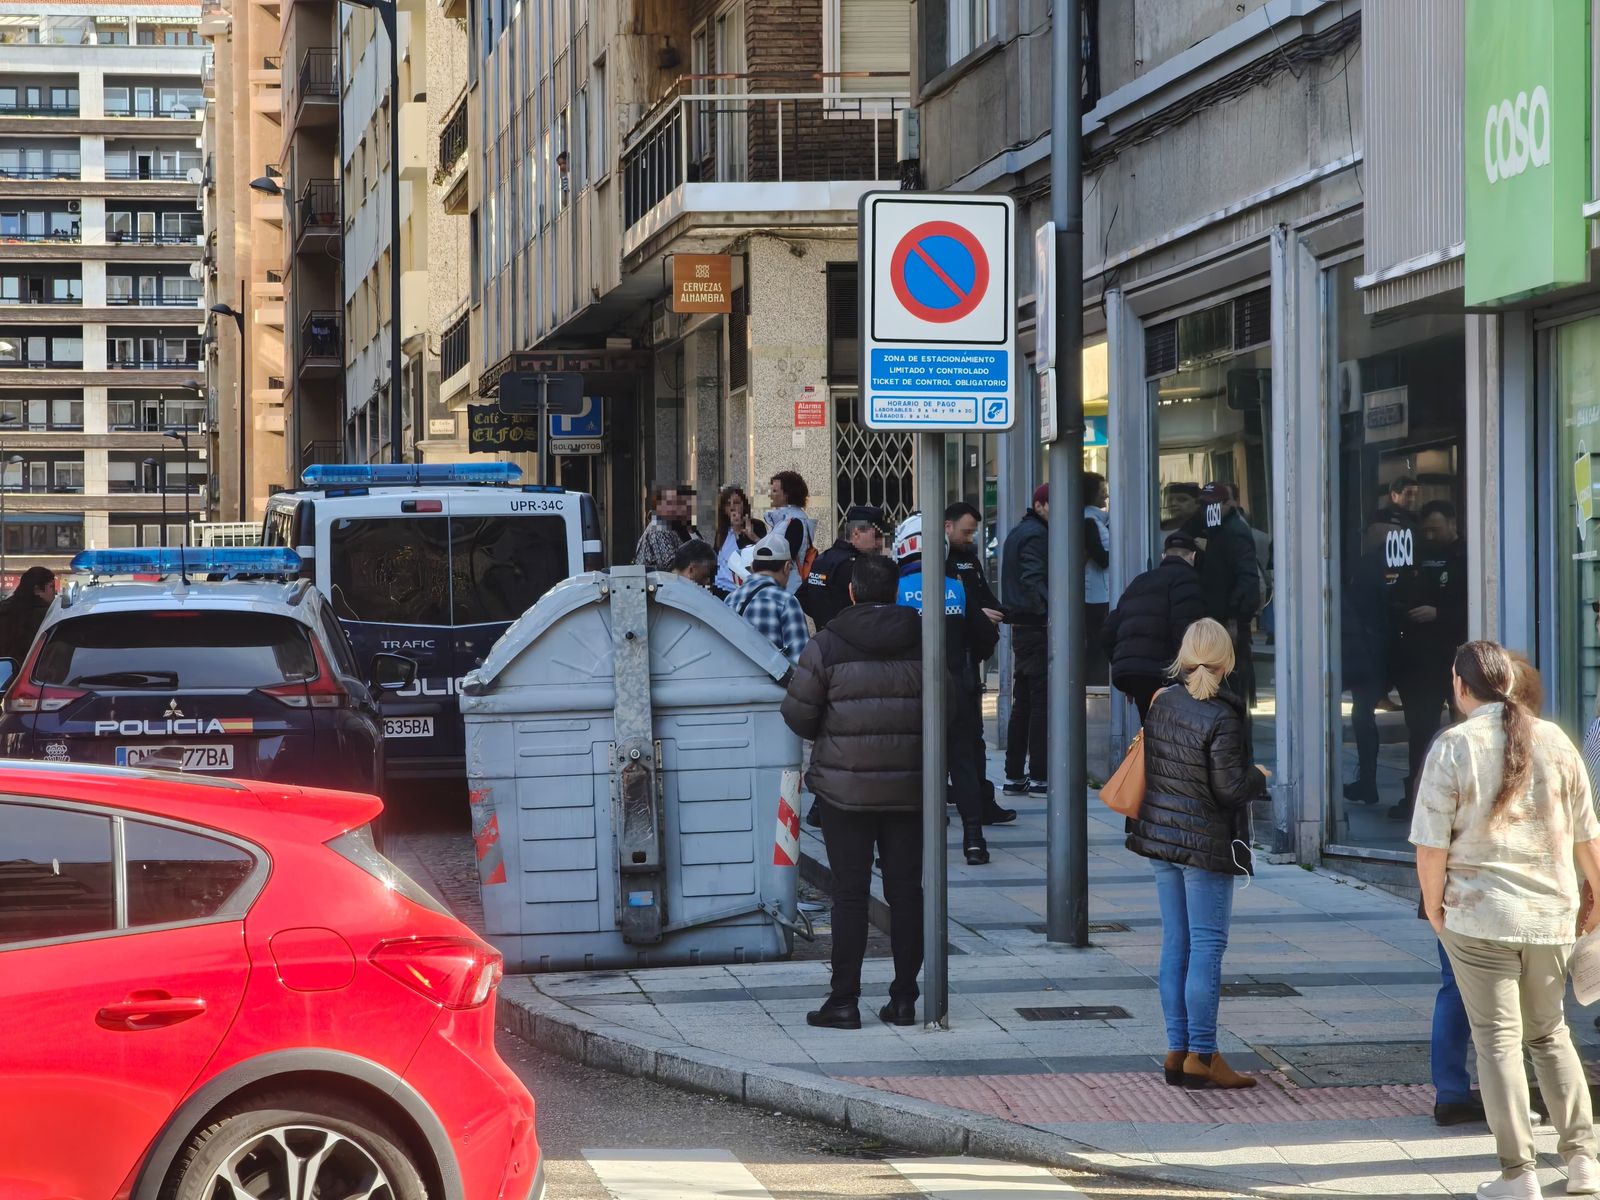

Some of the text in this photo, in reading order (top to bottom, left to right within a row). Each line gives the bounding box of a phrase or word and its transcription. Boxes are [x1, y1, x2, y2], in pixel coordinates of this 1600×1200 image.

[1484, 84, 1551, 184] casa
[683, 282, 722, 292] CERVEZAS
[680, 293, 725, 303] ALHAMBRA
[883, 354, 906, 362] ZONA
[921, 355, 996, 364] ESTACIONAMIENTO
[936, 367, 989, 375] CONTROLADO
[902, 378, 913, 386] DE
[915, 378, 952, 386] CONTROL
[955, 379, 1007, 387] OBLIGATORIO
[887, 400, 919, 408] HORARIO
[474, 411, 500, 425] Café
[472, 427, 537, 443] ELFOS
[553, 443, 574, 451] SOLO
[510, 500, 564, 511] UPR-34C
[1385, 527, 1414, 568] casa
[381, 640, 435, 649] TRAFIC
[384, 720, 430, 735] 635BA
